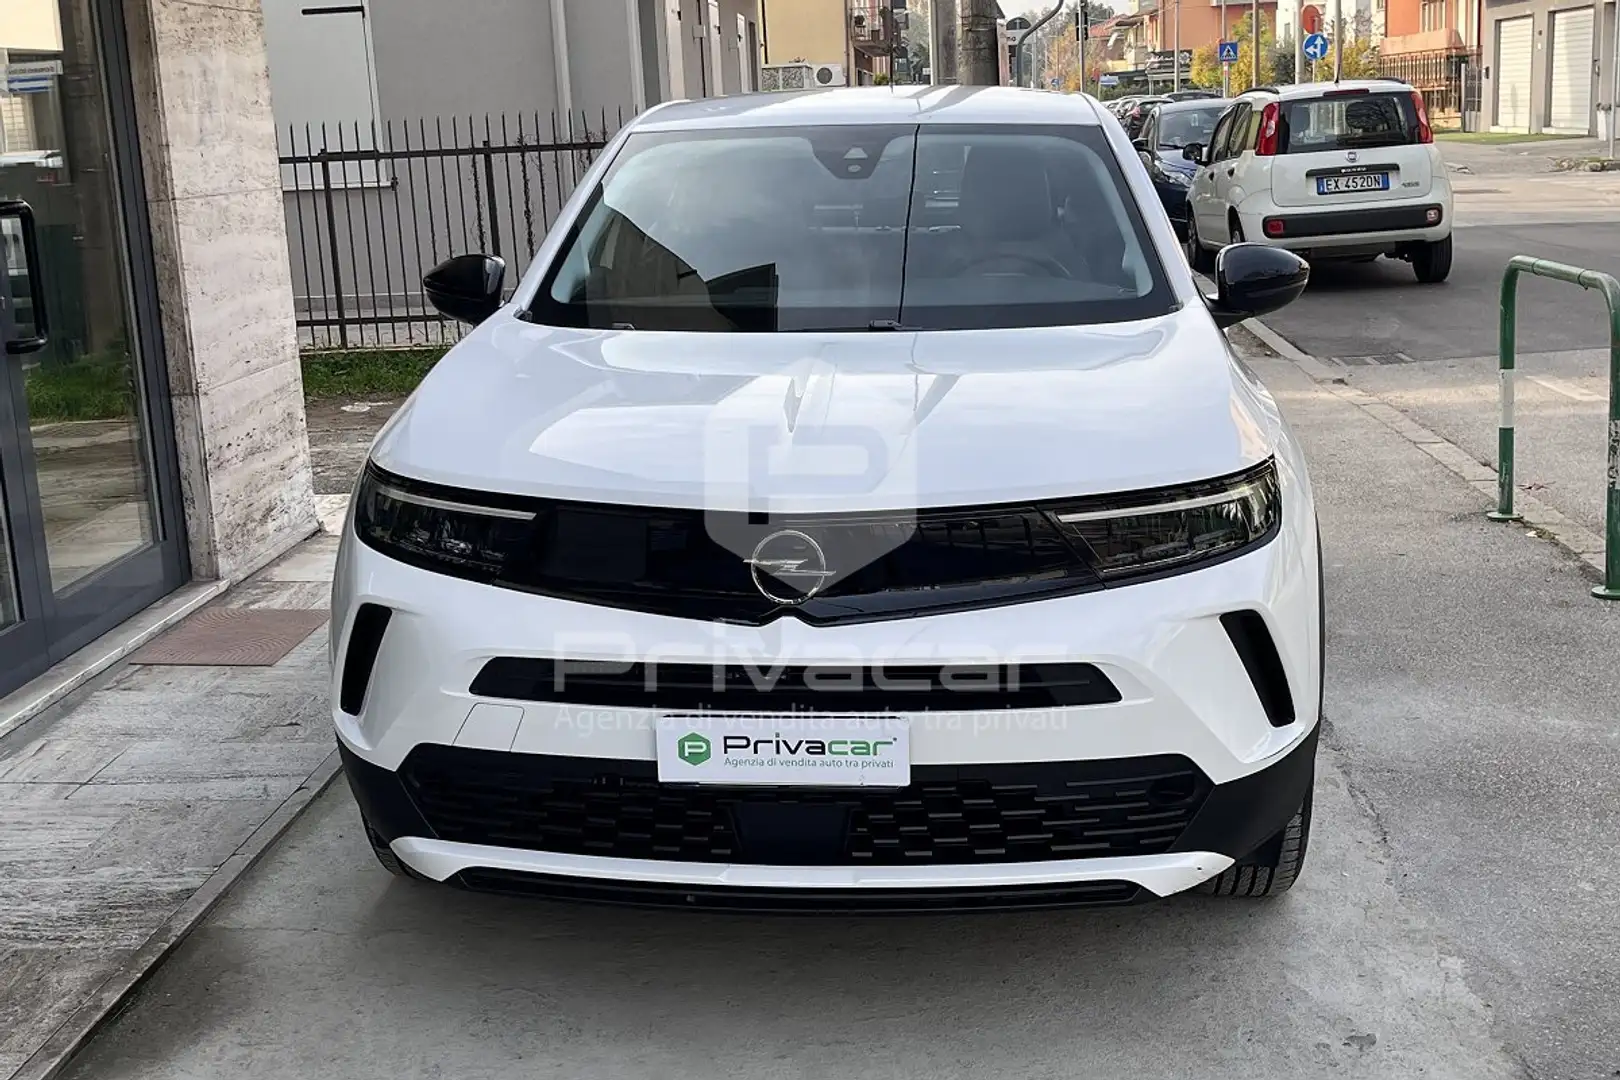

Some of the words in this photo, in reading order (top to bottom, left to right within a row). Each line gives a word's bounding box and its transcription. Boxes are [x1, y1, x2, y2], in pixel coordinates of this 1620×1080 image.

[723, 732, 894, 756] Privacar
[724, 757, 764, 768] Agenzia
[767, 757, 777, 766] di
[779, 758, 817, 767] vendita
[819, 759, 843, 768] auto
[845, 759, 859, 768] tra
[861, 759, 894, 770] privati
